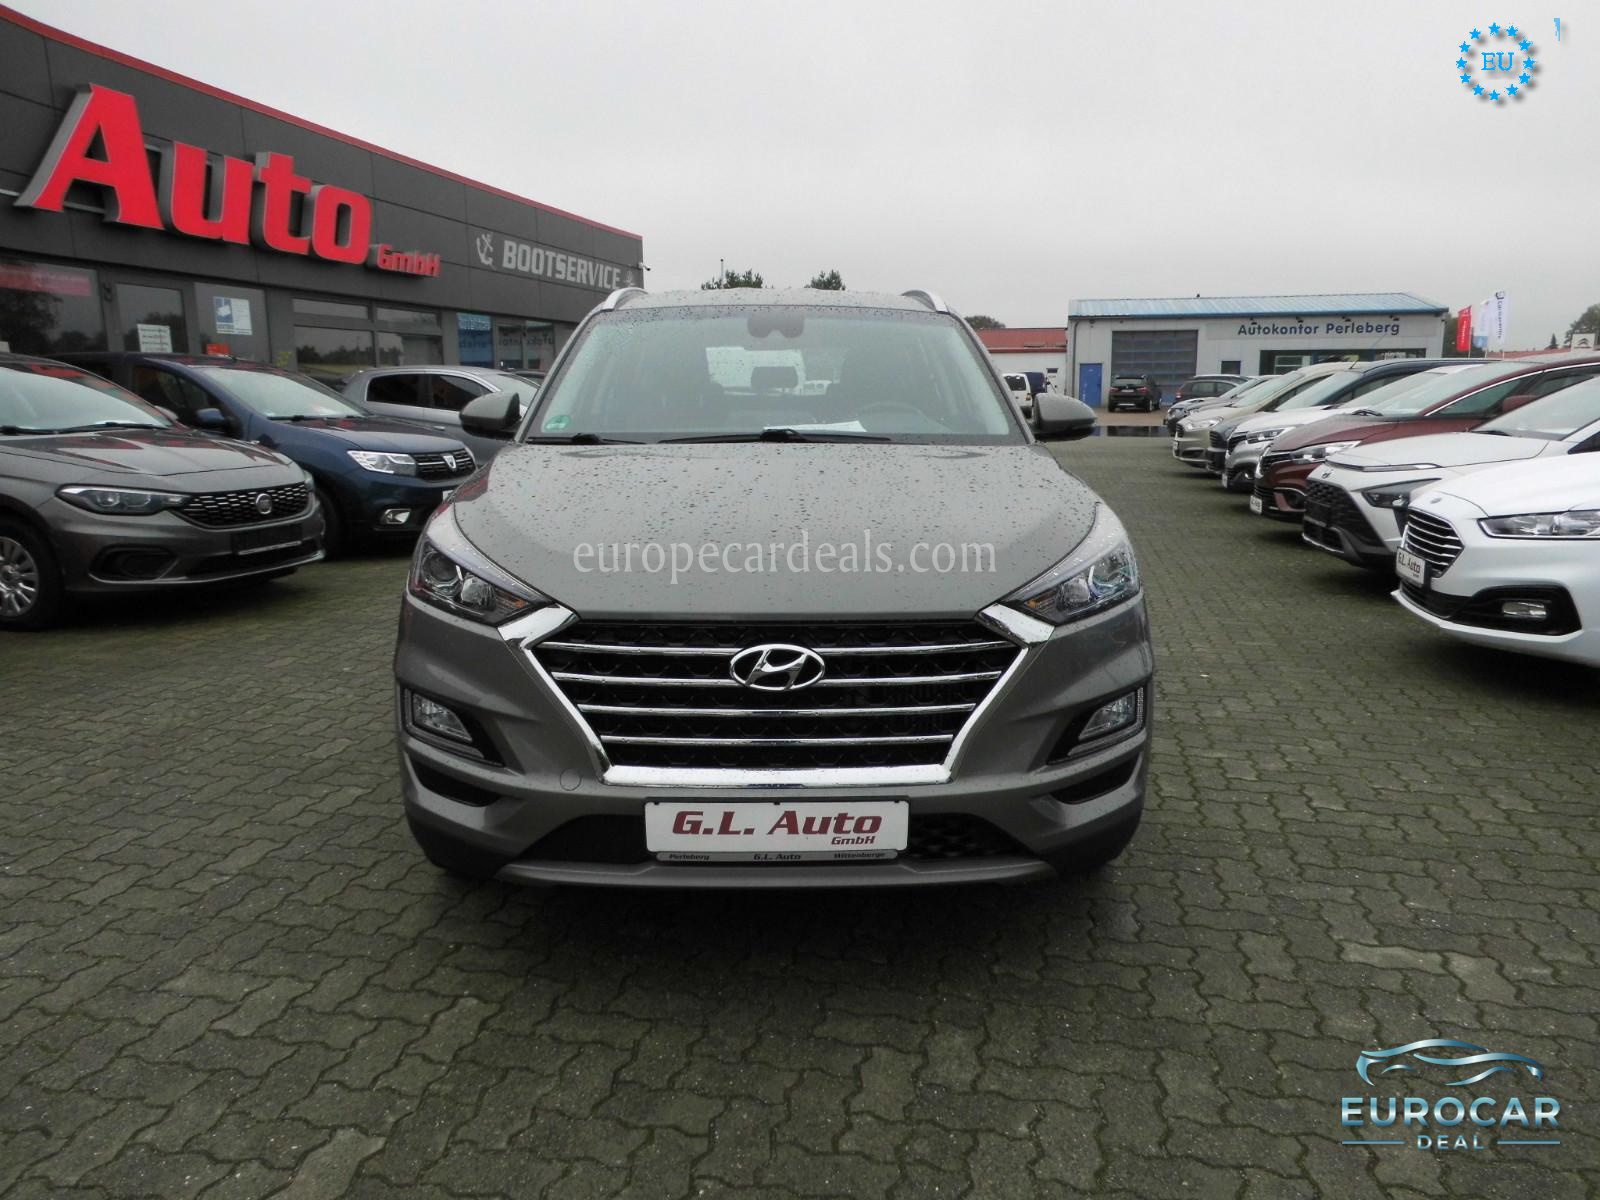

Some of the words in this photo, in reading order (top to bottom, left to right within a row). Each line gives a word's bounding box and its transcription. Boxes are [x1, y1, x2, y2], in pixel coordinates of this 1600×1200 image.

[28, 83, 372, 265] Auto
[377, 244, 441, 278] GmbH
[502, 240, 621, 290] BOOTSERVICE
[1238, 323, 1320, 336] Autokontor
[1326, 322, 1400, 336] Perleberg
[672, 810, 755, 836] G.L.
[767, 810, 882, 836] Auto
[831, 835, 876, 846] GmbH
[775, 853, 802, 861] Auto
